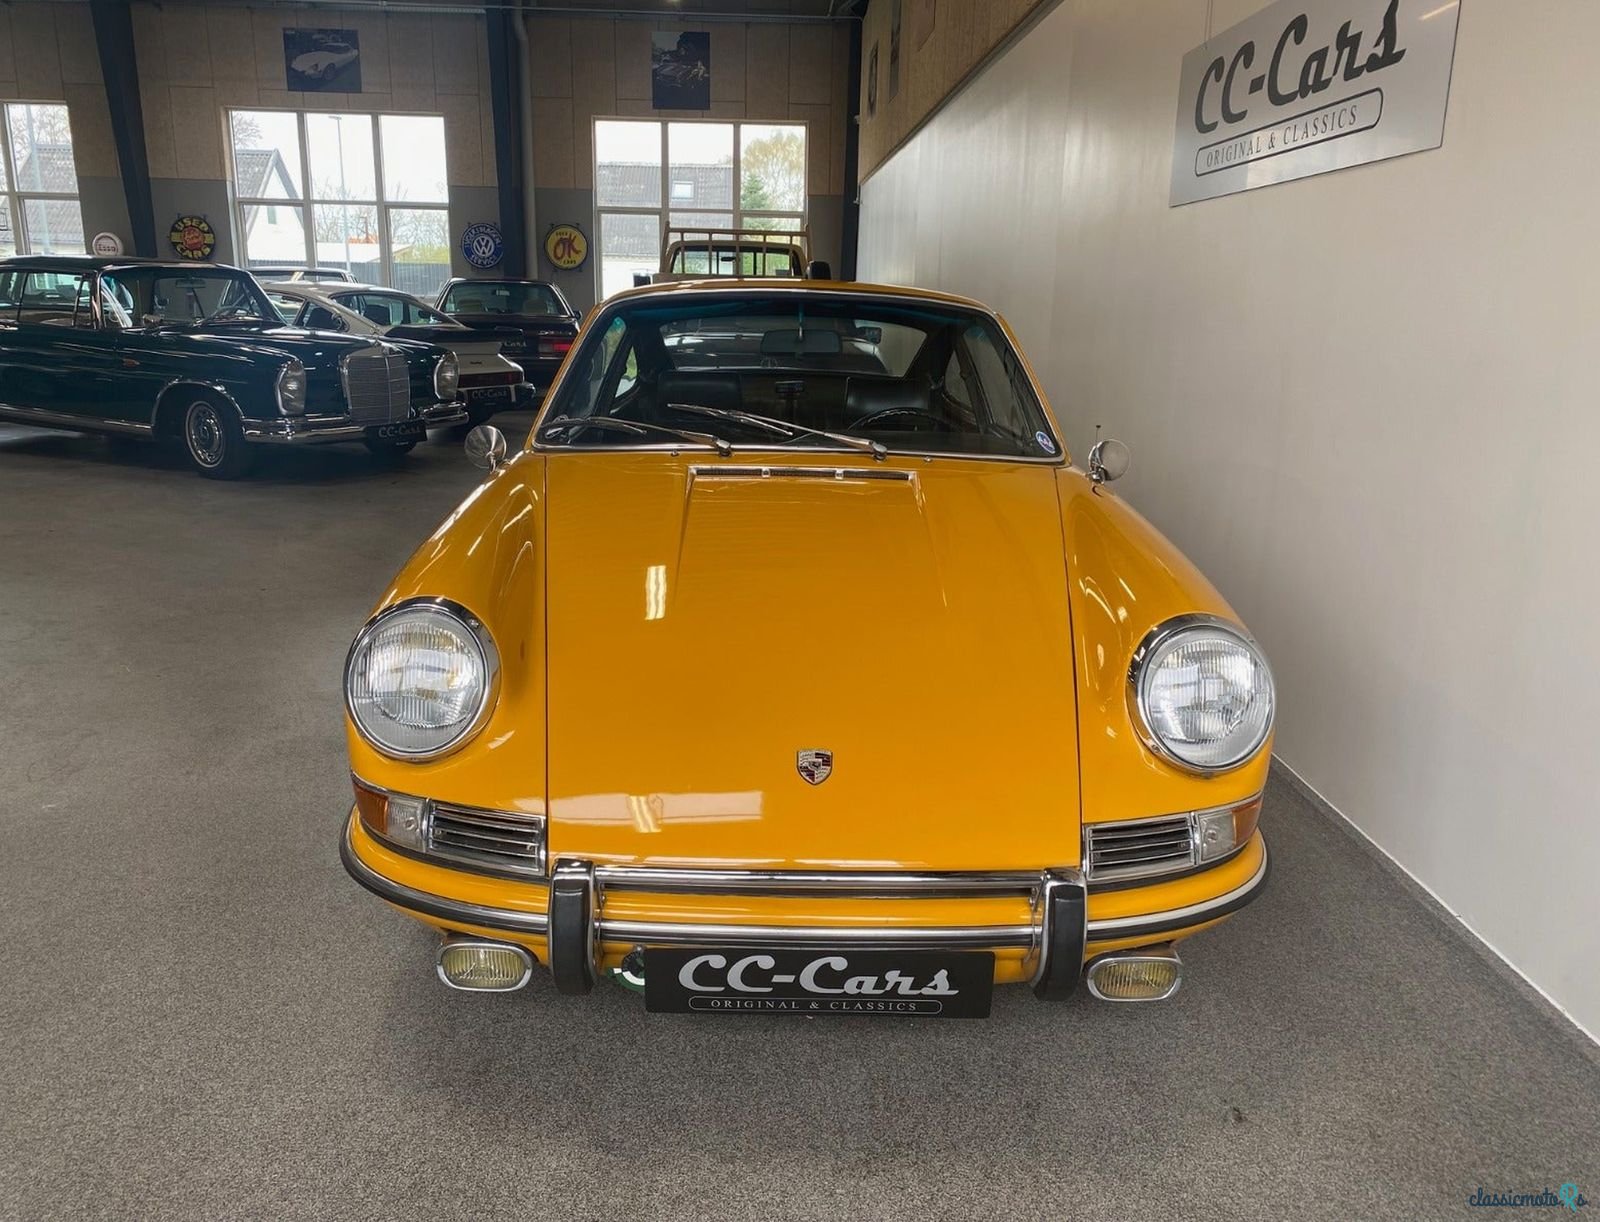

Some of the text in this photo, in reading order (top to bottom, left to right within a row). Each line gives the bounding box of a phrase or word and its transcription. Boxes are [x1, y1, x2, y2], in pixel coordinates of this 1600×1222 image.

[1195, 0, 1407, 134] CC-Cars
[1206, 104, 1358, 168] ORIGINAL & CLASSICS
[175, 217, 209, 232] USED
[176, 243, 211, 259] CARS
[553, 233, 582, 260] OK
[678, 954, 959, 996] CC-Cars
[710, 1000, 918, 1012] ORIGINAL & CLASSICS
